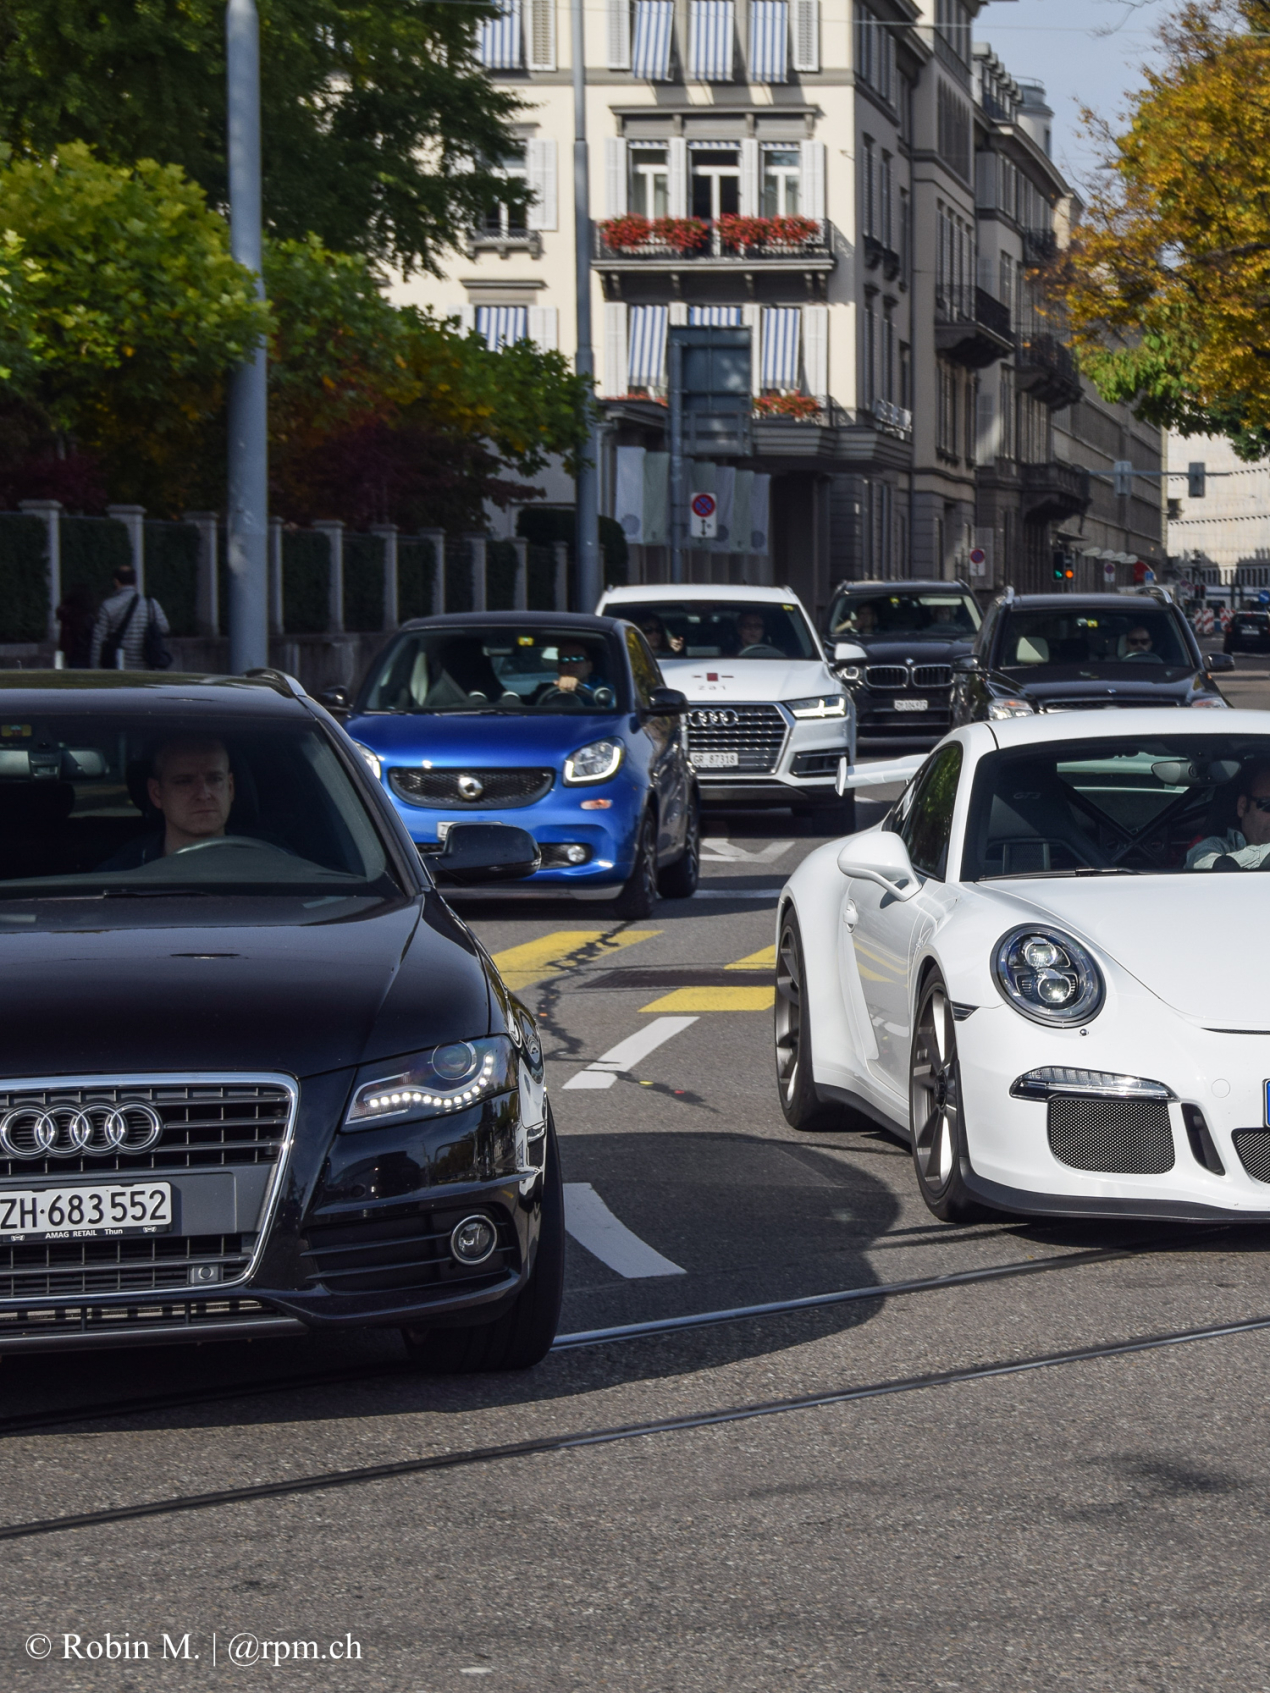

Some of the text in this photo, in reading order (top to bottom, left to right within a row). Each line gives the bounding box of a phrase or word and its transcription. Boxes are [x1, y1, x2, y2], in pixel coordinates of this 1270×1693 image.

[45, 1228, 123, 1239] AMAG RETAIL Thun
